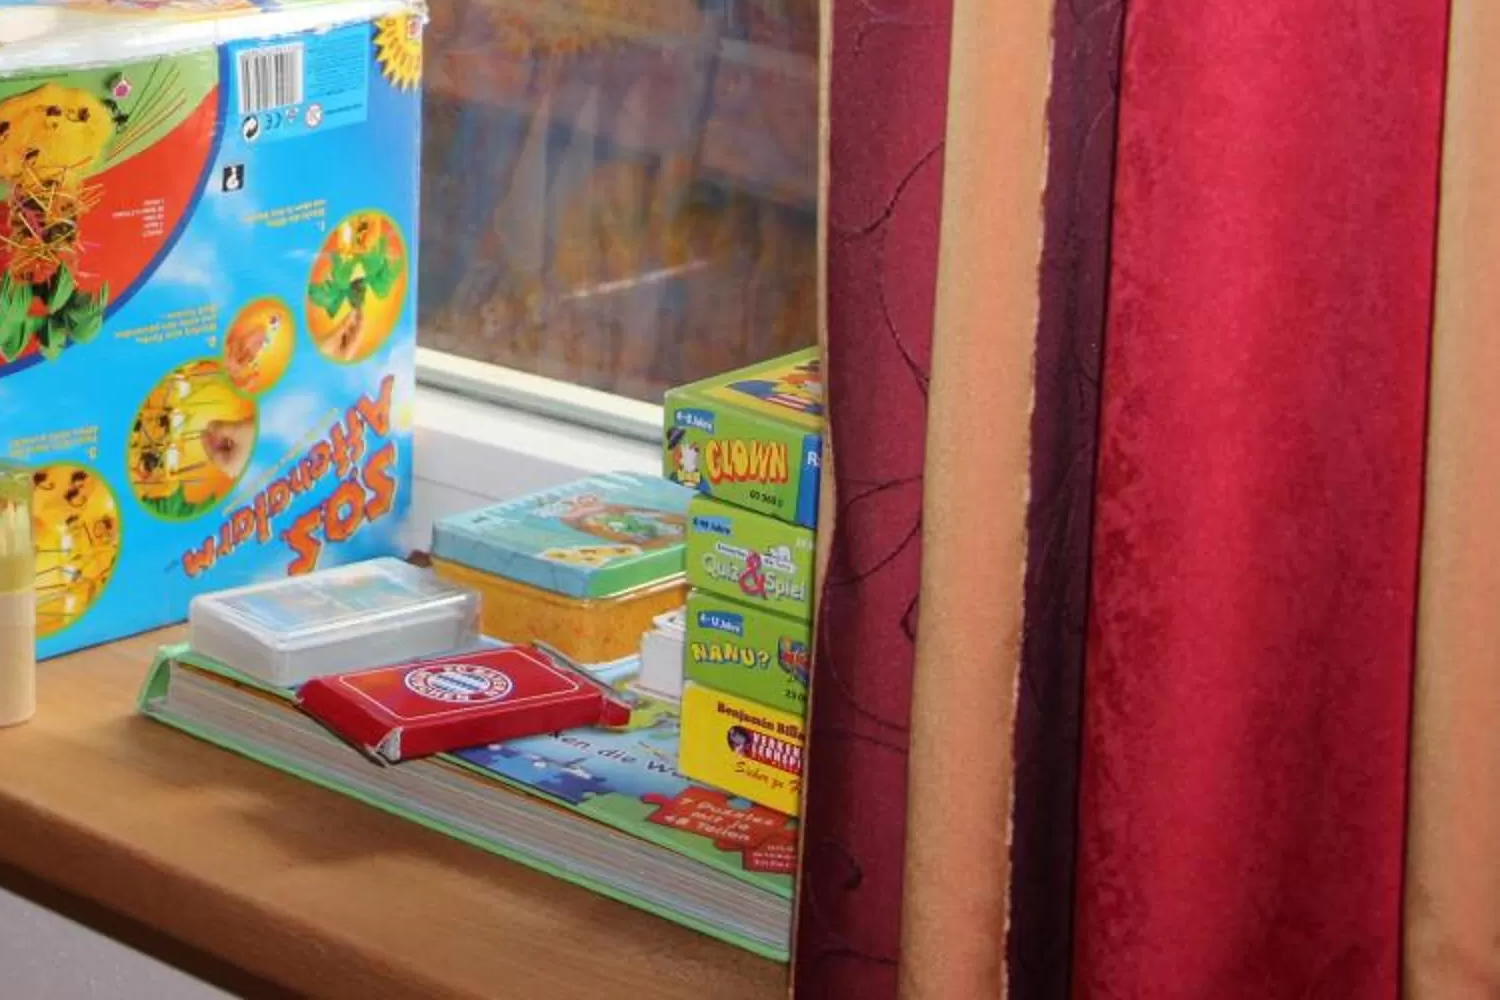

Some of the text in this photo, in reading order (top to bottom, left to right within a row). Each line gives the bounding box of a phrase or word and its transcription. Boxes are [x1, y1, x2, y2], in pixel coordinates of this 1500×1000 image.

[705, 439, 789, 485] CLOWN
[766, 572, 805, 602] Spiel
[717, 701, 775, 731] Benjamin
